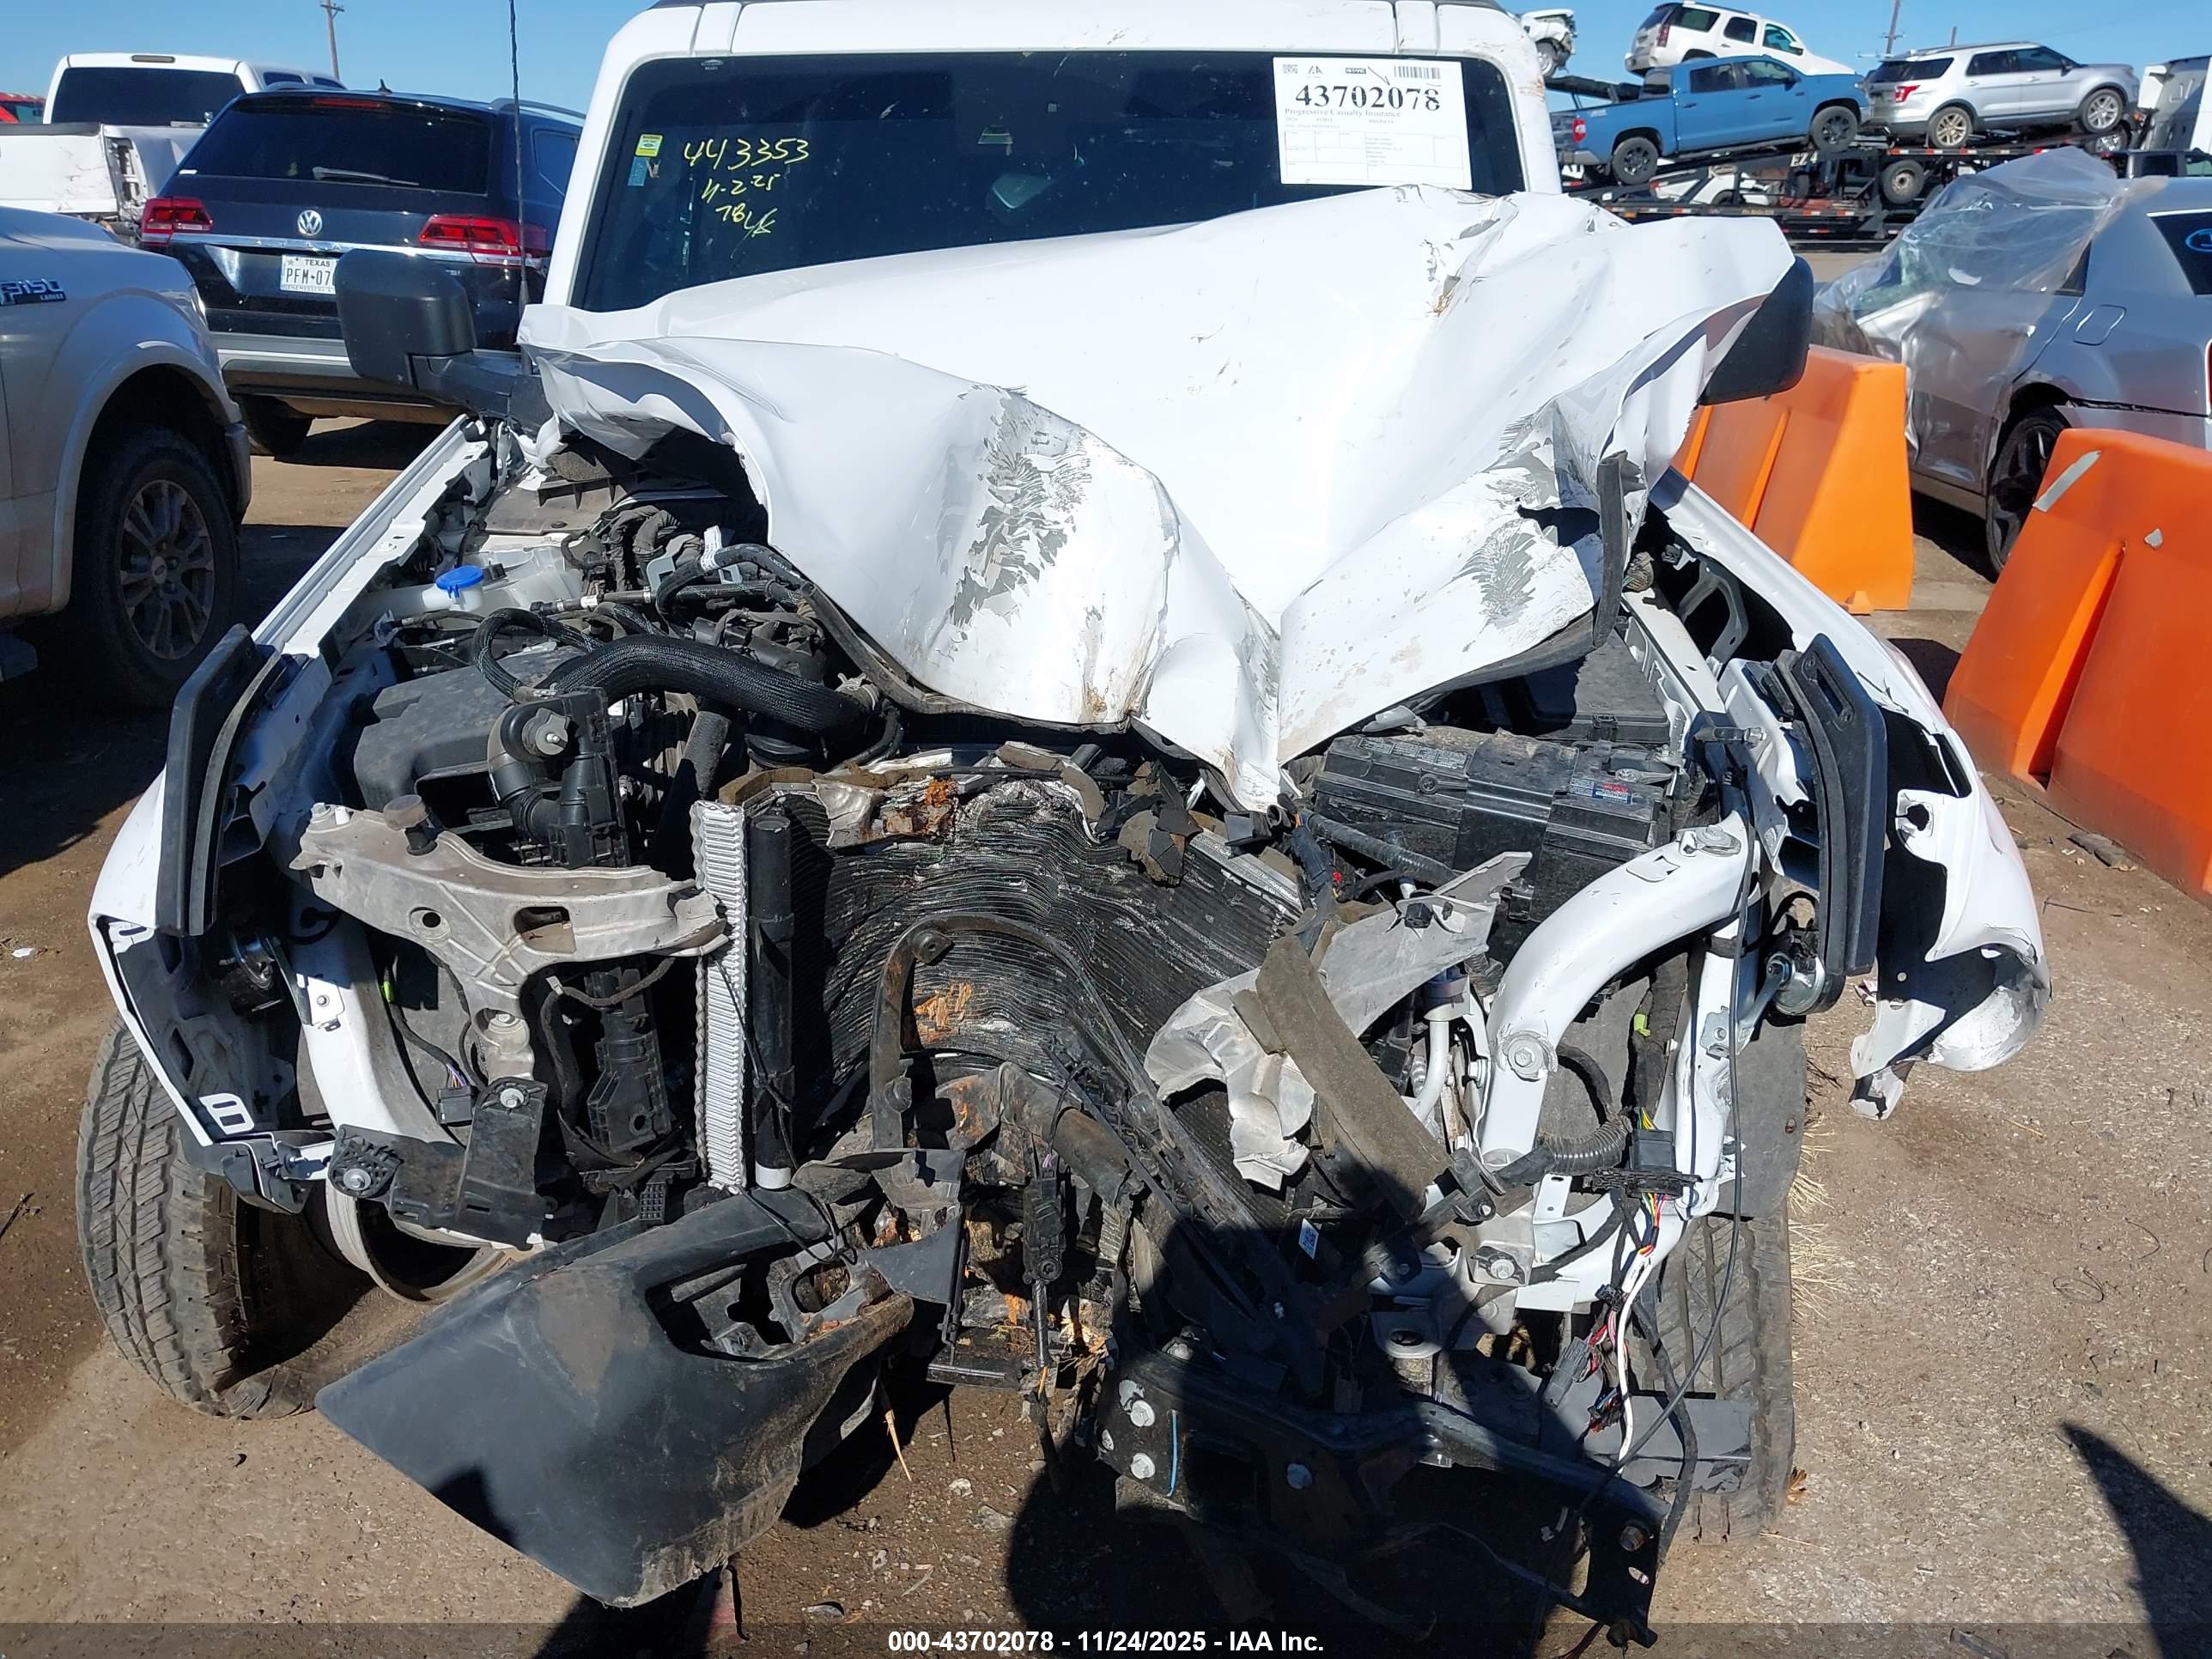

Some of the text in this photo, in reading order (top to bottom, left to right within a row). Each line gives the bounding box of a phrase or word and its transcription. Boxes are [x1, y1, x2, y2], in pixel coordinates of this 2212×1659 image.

[1295, 84, 1441, 111] 43702078
[1365, 109, 1401, 118] Insurance
[305, 258, 331, 267] TEXAS
